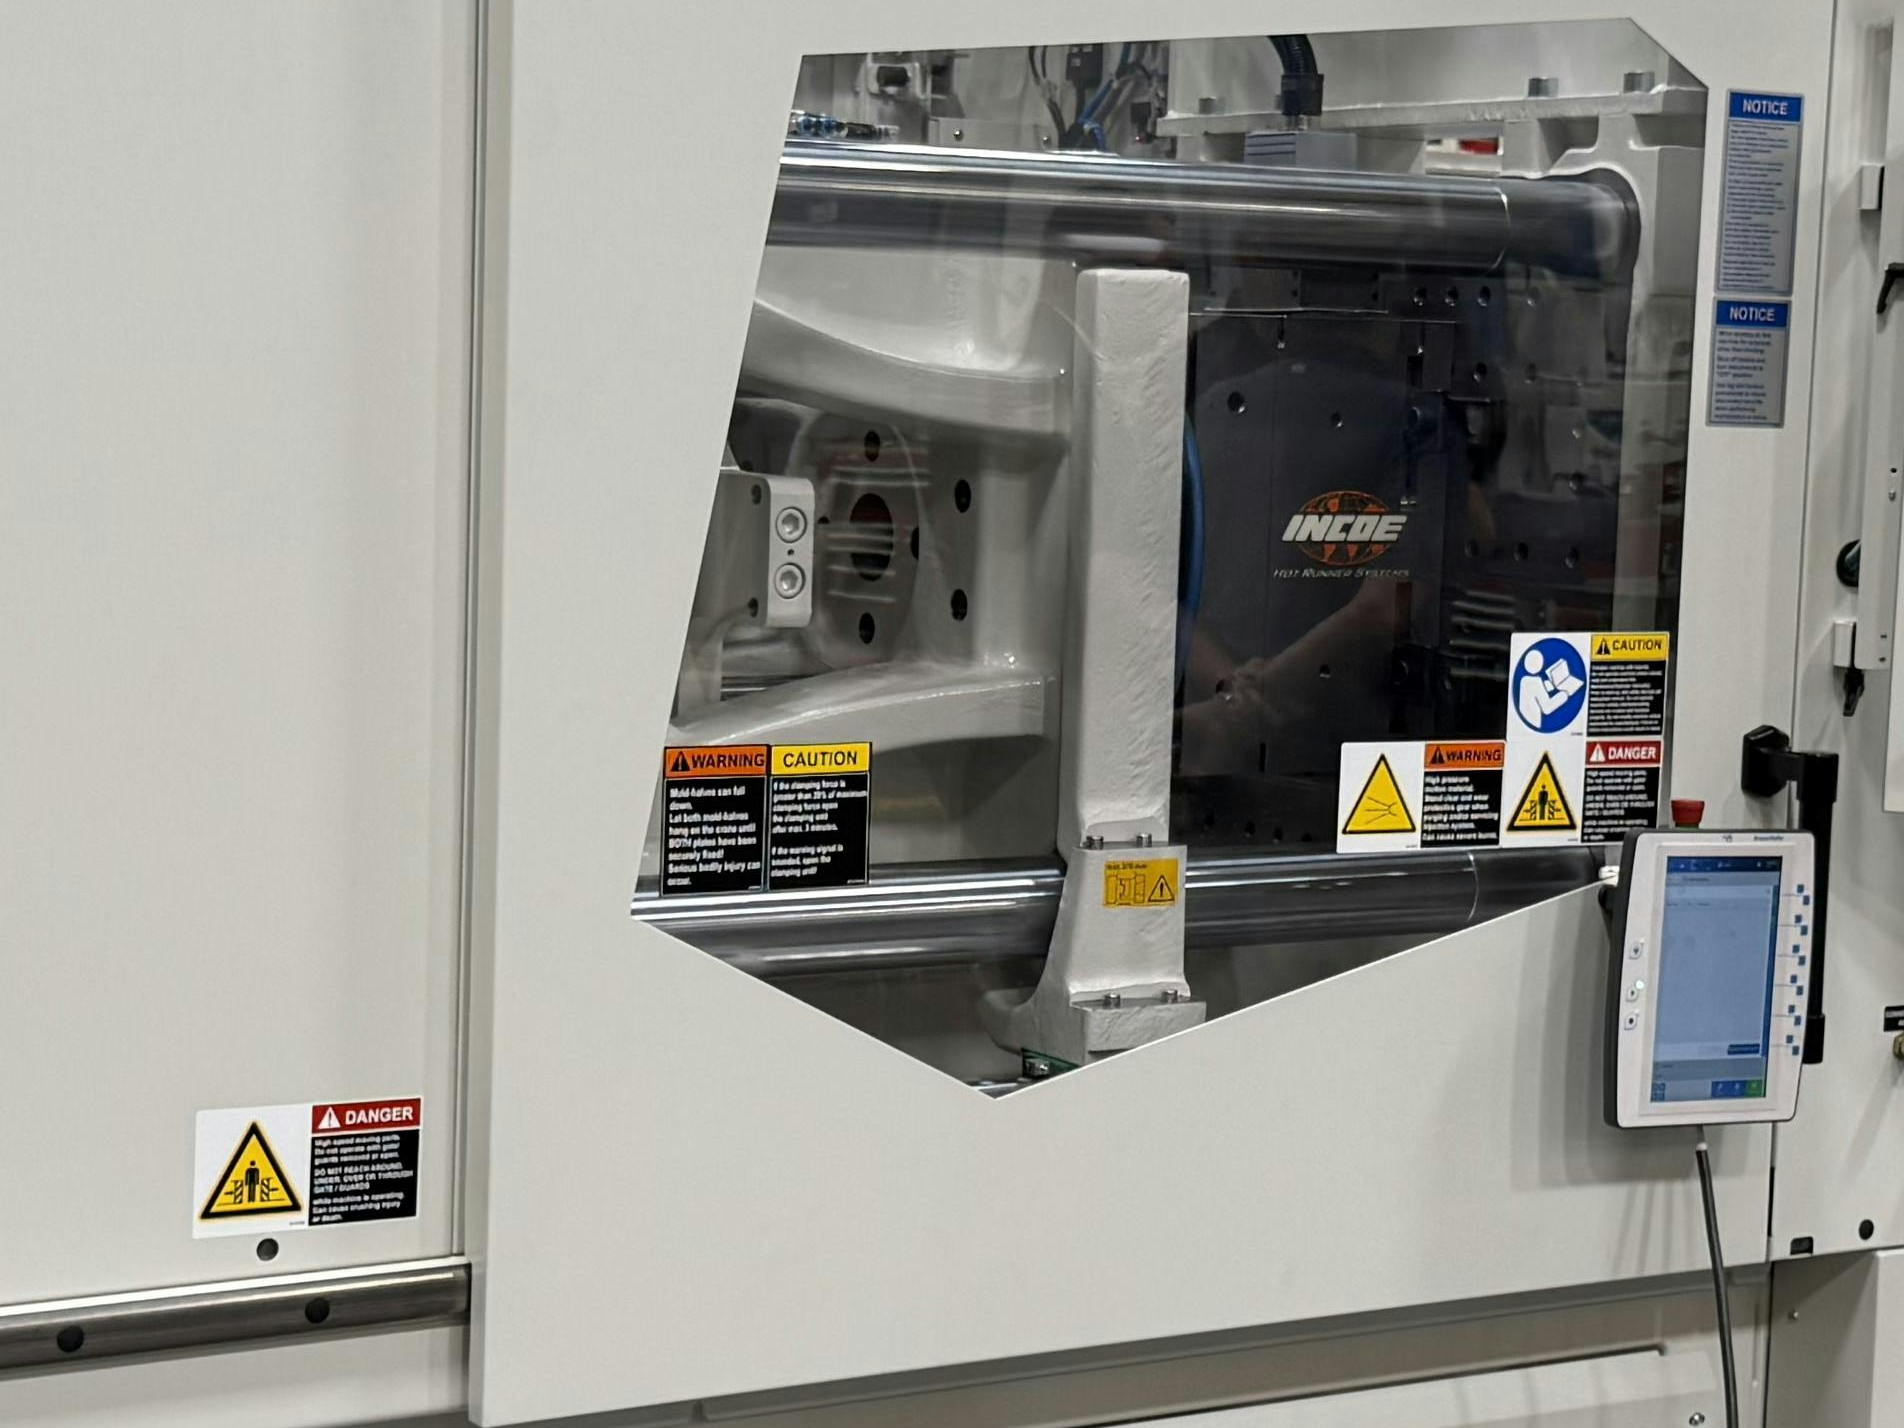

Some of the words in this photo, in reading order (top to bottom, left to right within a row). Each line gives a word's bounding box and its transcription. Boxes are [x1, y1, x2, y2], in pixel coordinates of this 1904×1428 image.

[1743, 99, 1788, 115] NOTICE
[1730, 307, 1776, 321] NOTICE
[1281, 514, 1407, 542] INCOE
[1612, 639, 1662, 651] CAUTION
[692, 753, 765, 769] WARNING
[783, 751, 857, 768] CAUTION
[1447, 750, 1501, 761] WARNING
[1608, 746, 1656, 760] DANGER
[345, 1106, 413, 1125] DANGER
